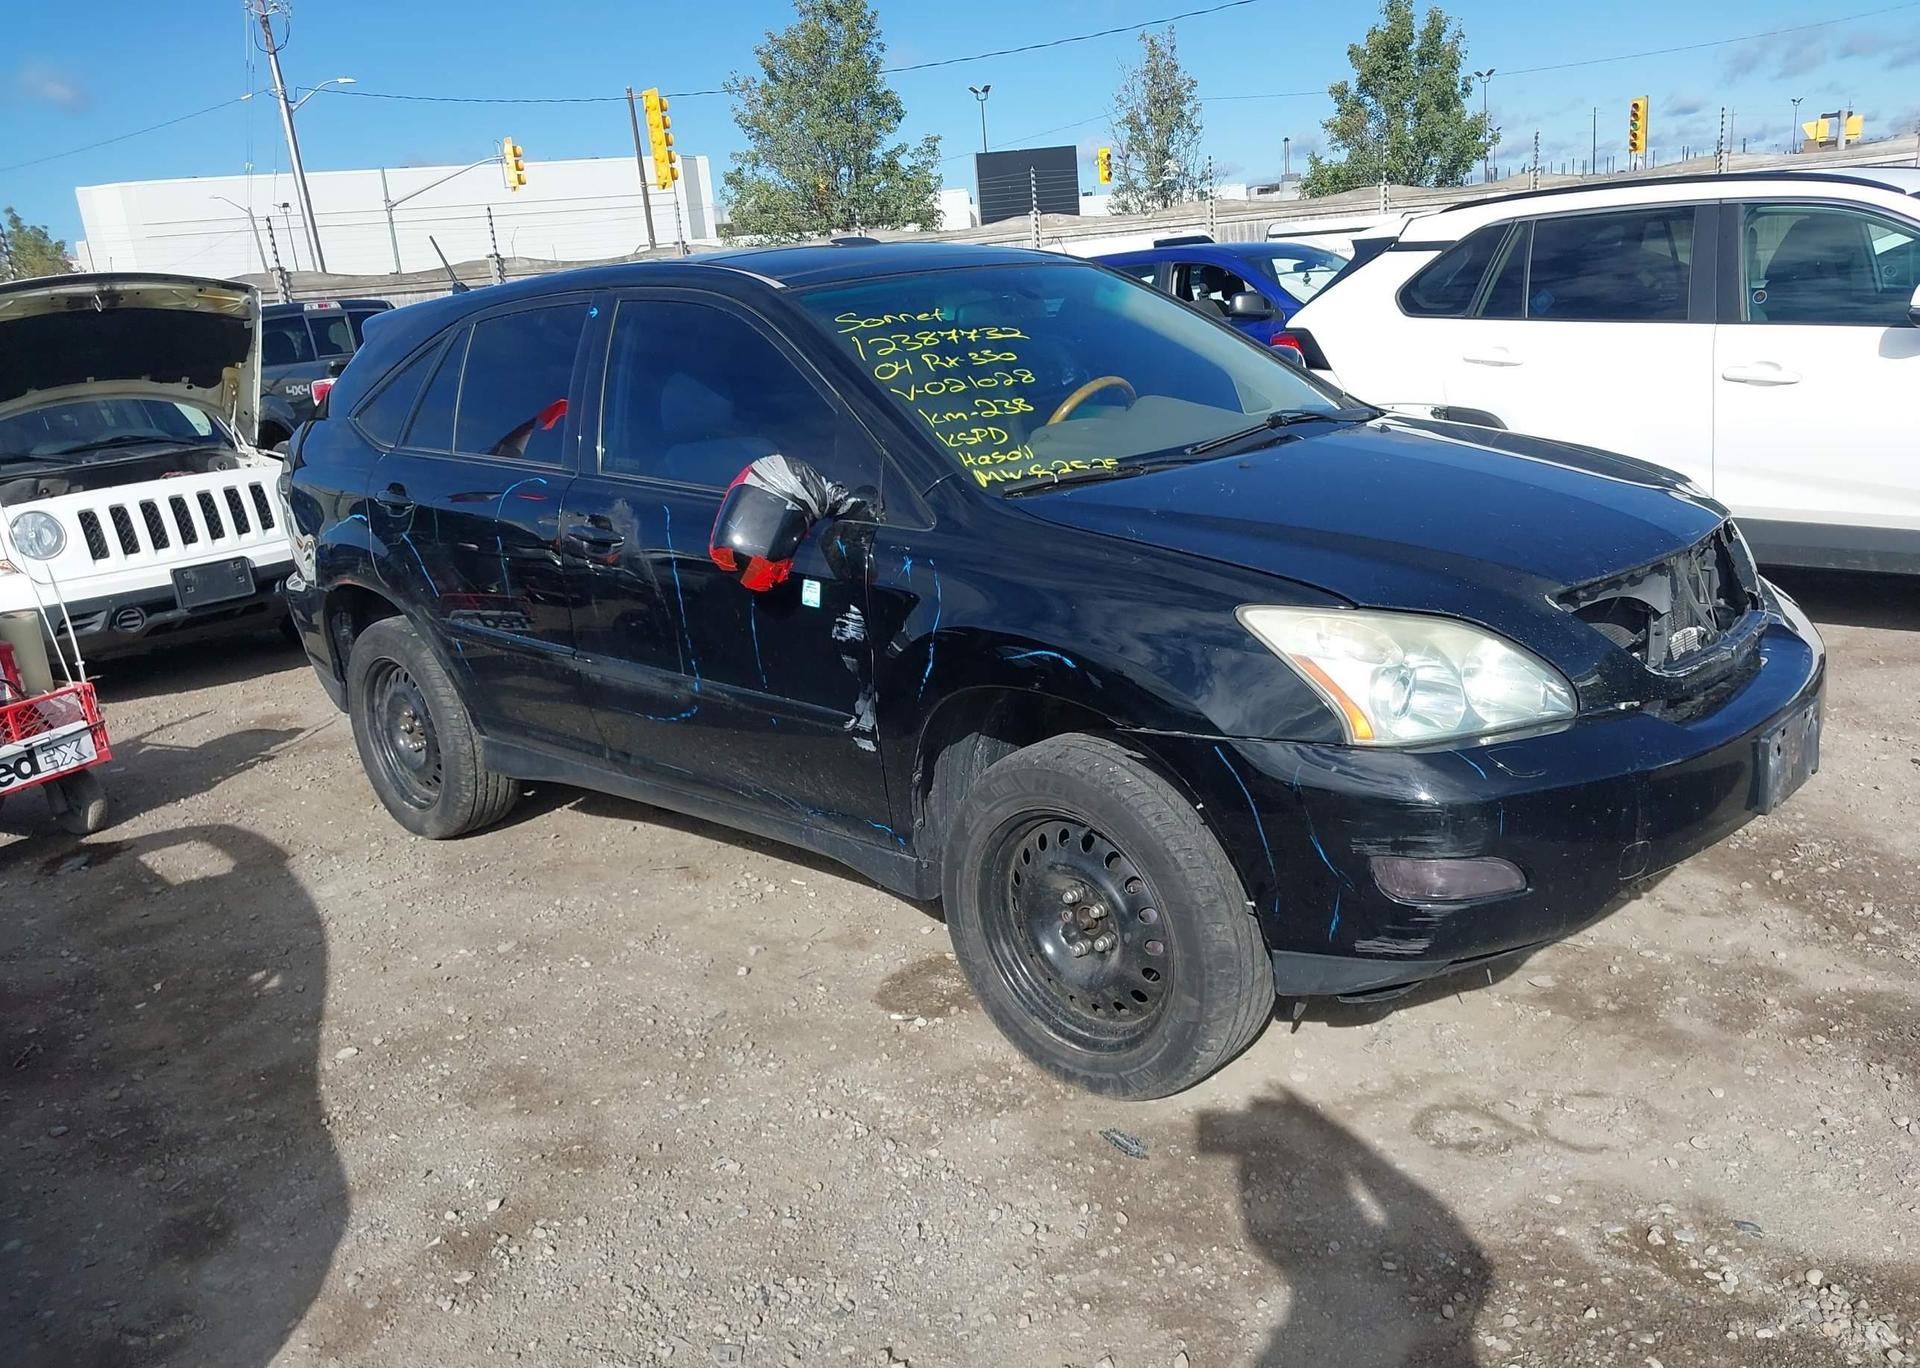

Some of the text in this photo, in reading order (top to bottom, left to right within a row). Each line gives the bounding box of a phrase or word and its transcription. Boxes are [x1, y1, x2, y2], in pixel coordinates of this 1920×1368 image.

[851, 327, 1031, 361] 12387732
[874, 359, 914, 380] 04
[0, 737, 87, 788] edEx
